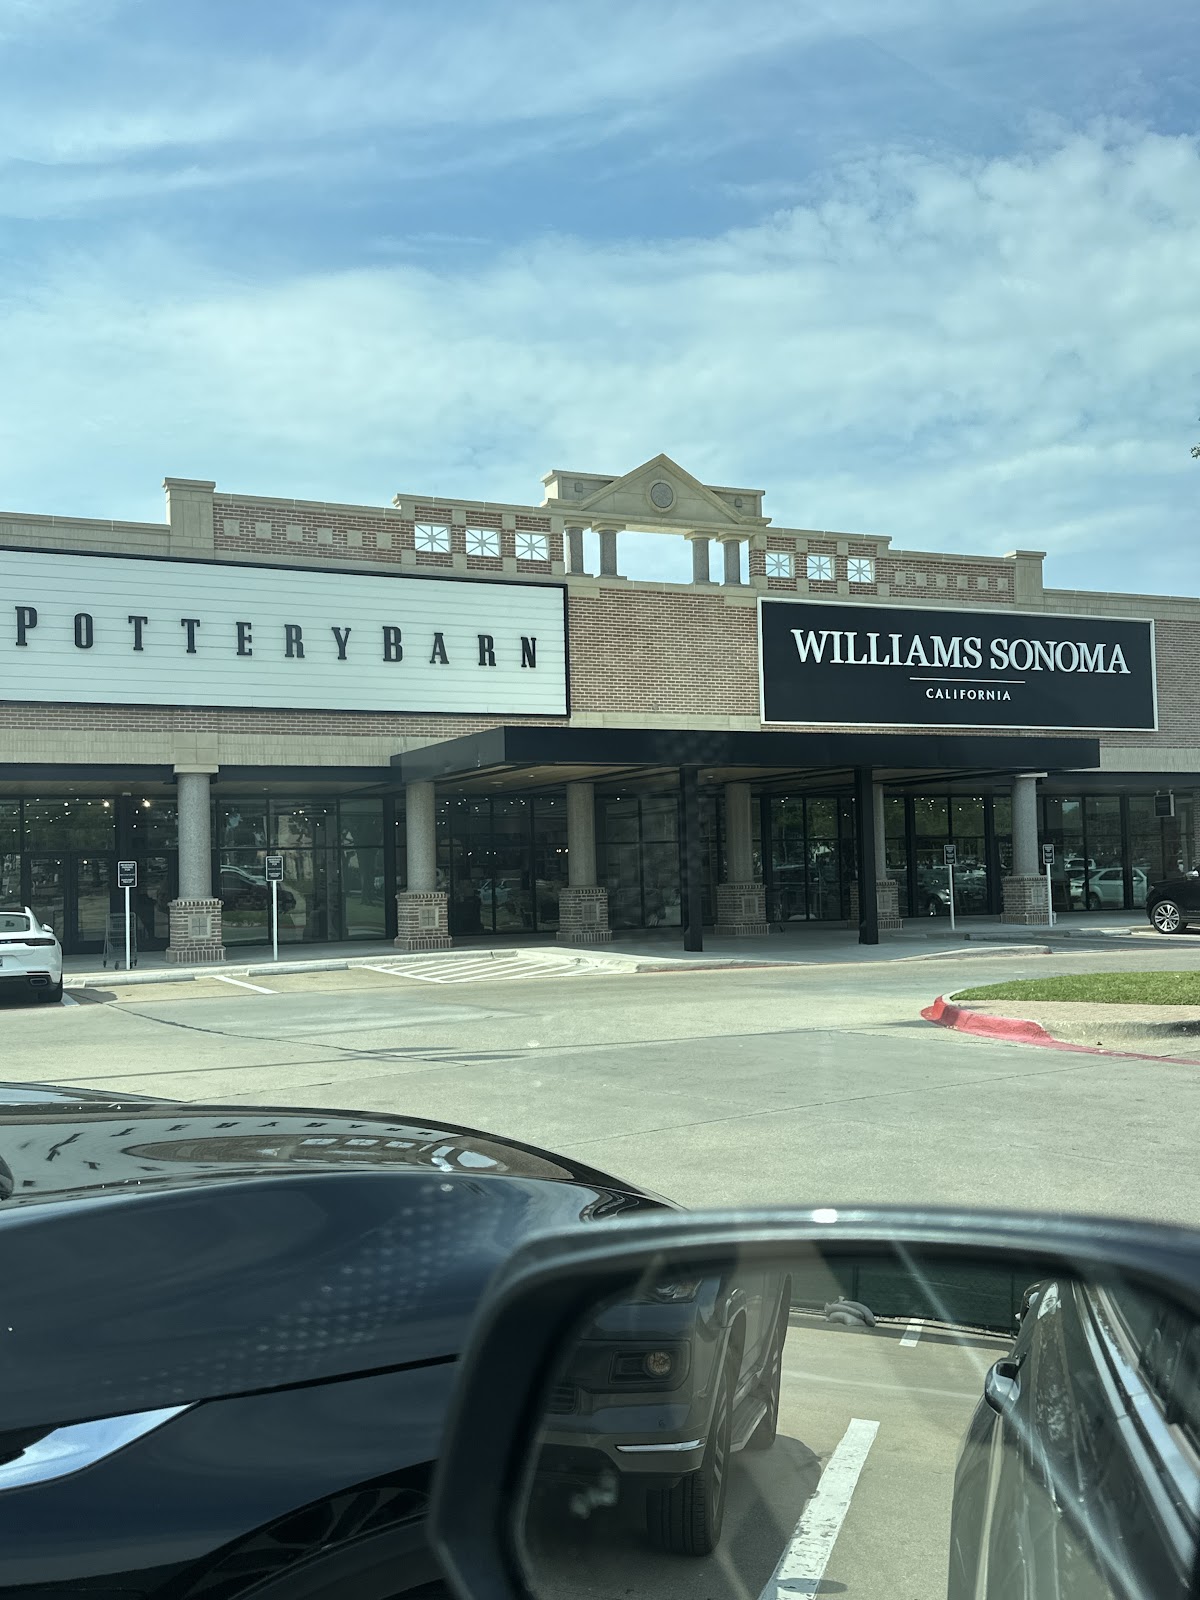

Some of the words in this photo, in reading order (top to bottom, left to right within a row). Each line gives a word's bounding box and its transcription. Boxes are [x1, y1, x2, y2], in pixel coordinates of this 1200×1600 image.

[15, 605, 352, 660] POTTERY
[382, 625, 537, 668] BARN
[790, 629, 982, 669] WILLIAMS
[990, 636, 1131, 674] SONOMA
[925, 687, 1011, 701] CALIFORNIA
